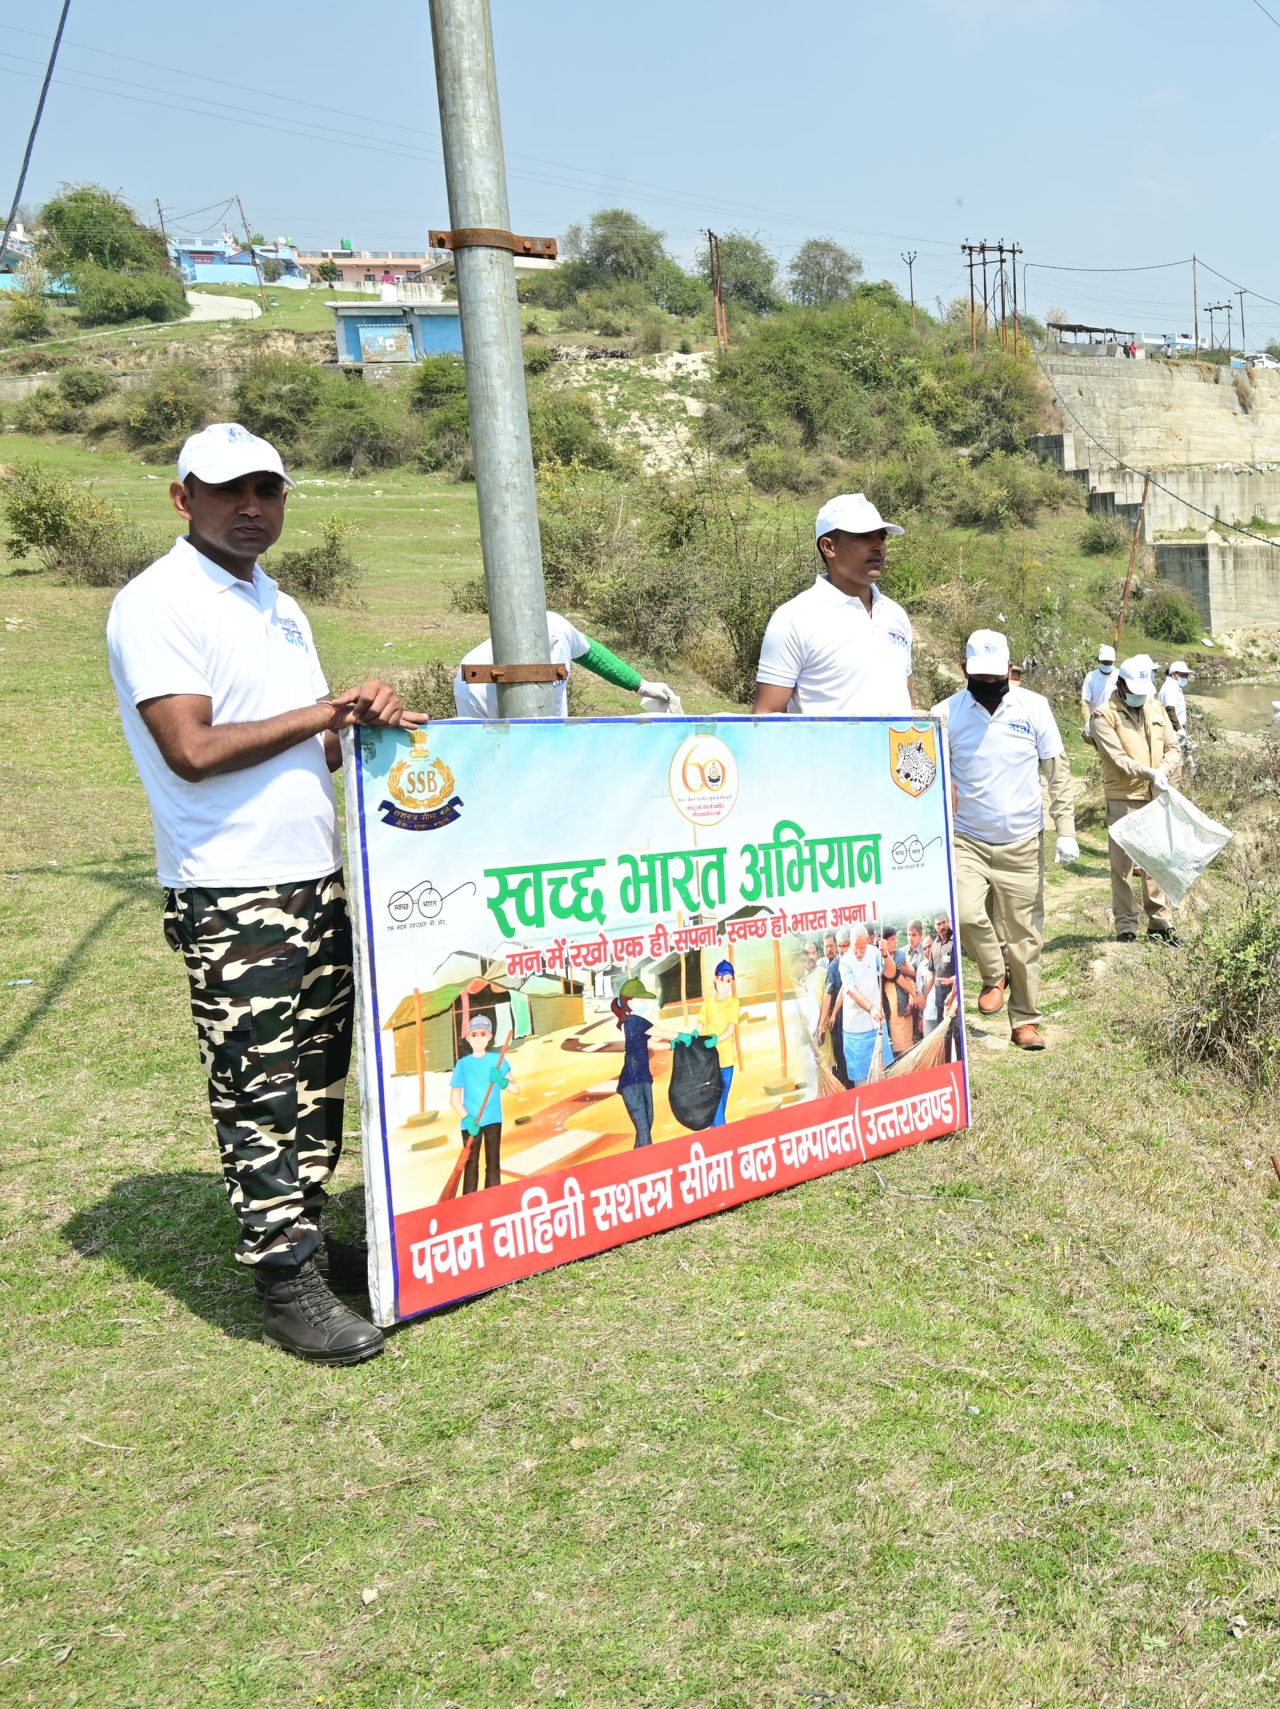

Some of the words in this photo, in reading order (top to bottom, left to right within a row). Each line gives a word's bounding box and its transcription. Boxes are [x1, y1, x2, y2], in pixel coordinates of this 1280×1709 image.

[407, 770, 438, 794] SSB
[483, 858, 606, 938] स्वच्छ
[617, 847, 727, 914] भारत
[739, 819, 882, 901] अभियान
[505, 950, 542, 976] मन
[545, 938, 566, 970] में
[569, 933, 608, 967] रखो
[612, 935, 644, 961] एक
[648, 923, 670, 957] ही
[673, 925, 722, 953] सपना,
[726, 917, 767, 943] स्वच्छ
[770, 908, 787, 937] हो
[791, 909, 827, 933] भारत
[831, 903, 867, 928] अपना
[409, 1218, 485, 1284] पंचम
[490, 1176, 586, 1259] वाहिनी
[590, 1168, 674, 1232] सशस्त्र
[678, 1141, 734, 1204] सीमा
[738, 1137, 776, 1183] बल
